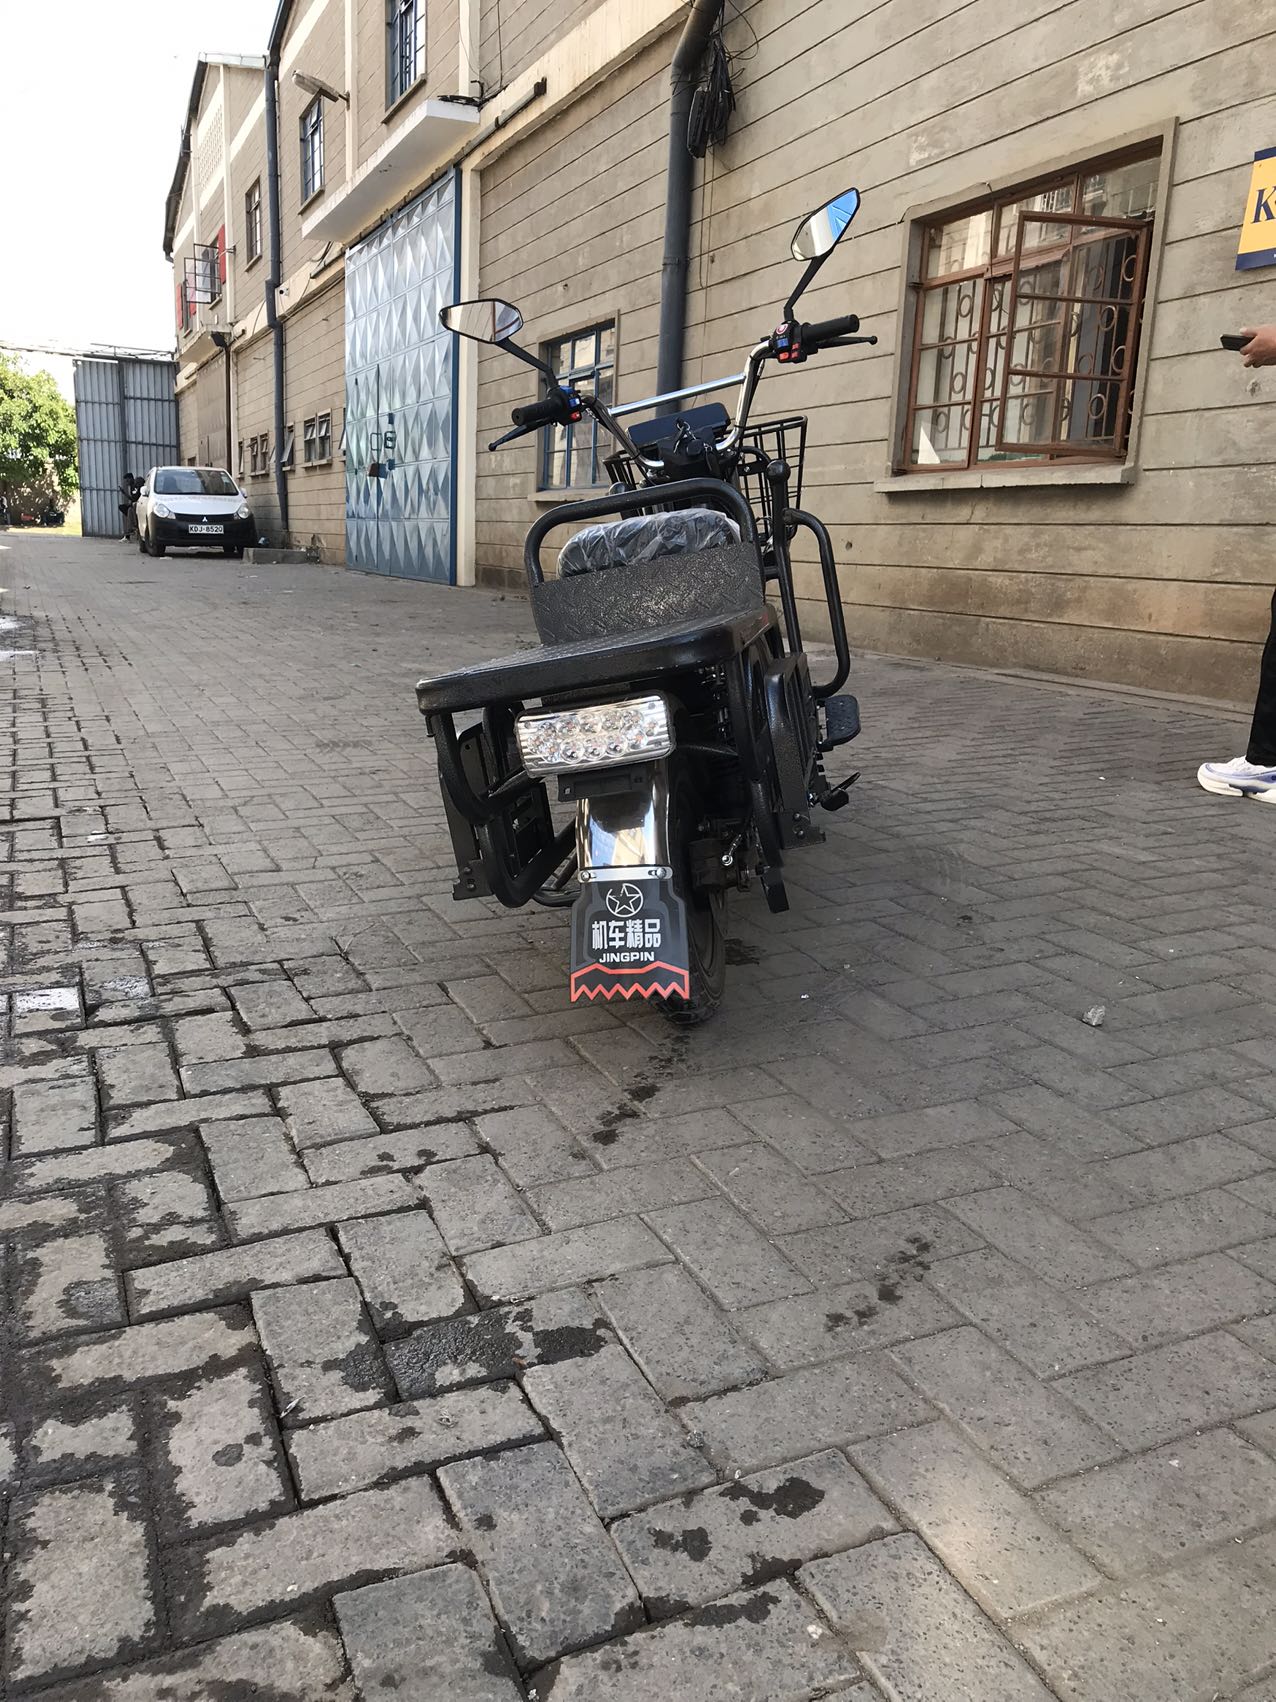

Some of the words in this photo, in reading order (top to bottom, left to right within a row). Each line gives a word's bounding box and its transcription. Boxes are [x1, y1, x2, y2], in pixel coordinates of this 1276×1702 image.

[1251, 186, 1276, 224] K
[592, 919, 661, 949] 机车精品
[599, 952, 655, 963] JINGPIN
